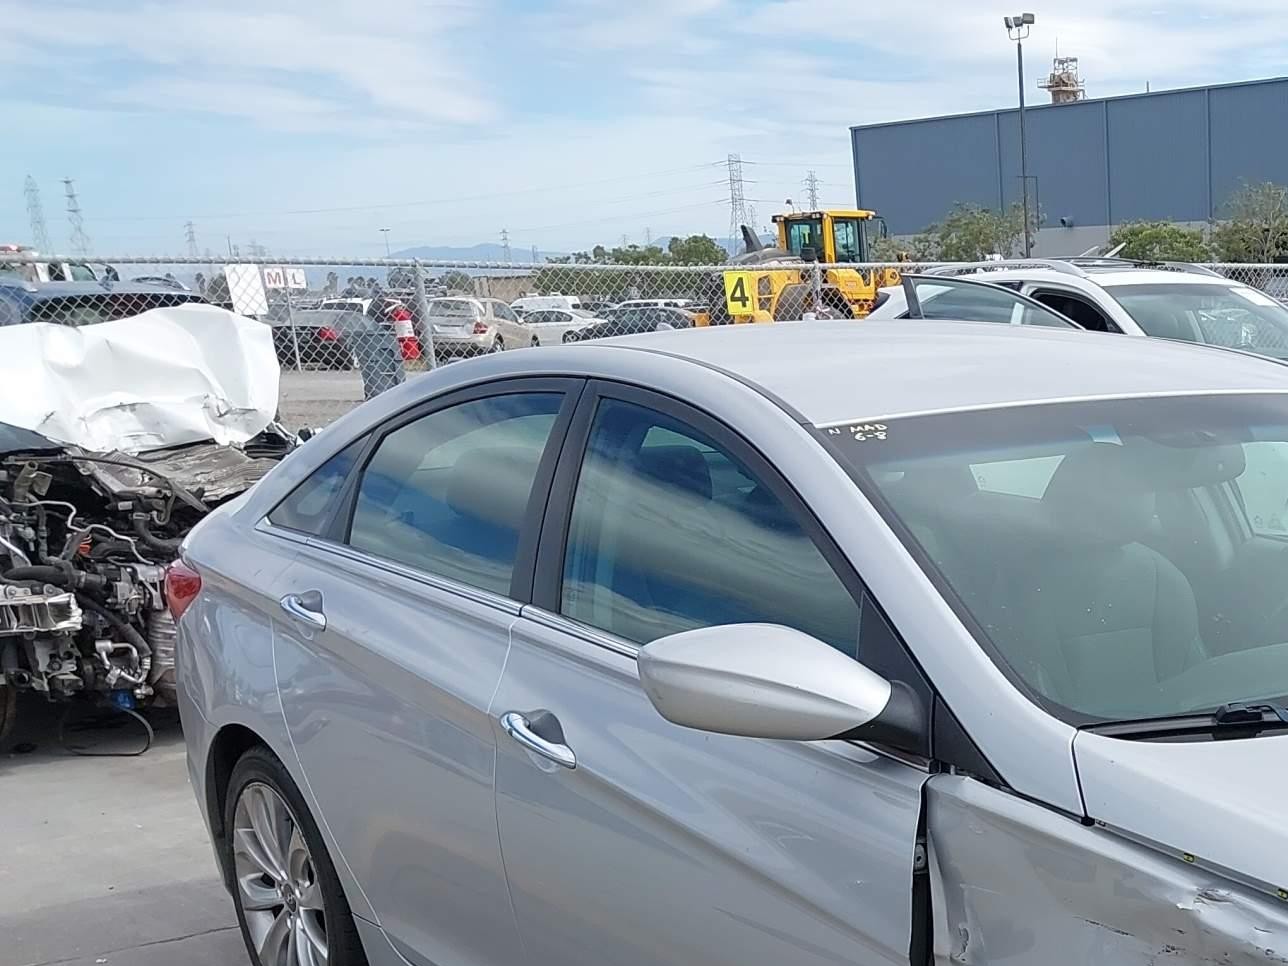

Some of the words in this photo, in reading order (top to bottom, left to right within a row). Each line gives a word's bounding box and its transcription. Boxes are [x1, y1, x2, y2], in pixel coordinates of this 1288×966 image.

[266, 271, 282, 286] M
[730, 277, 749, 308] 4
[854, 431, 887, 441] 6-8
